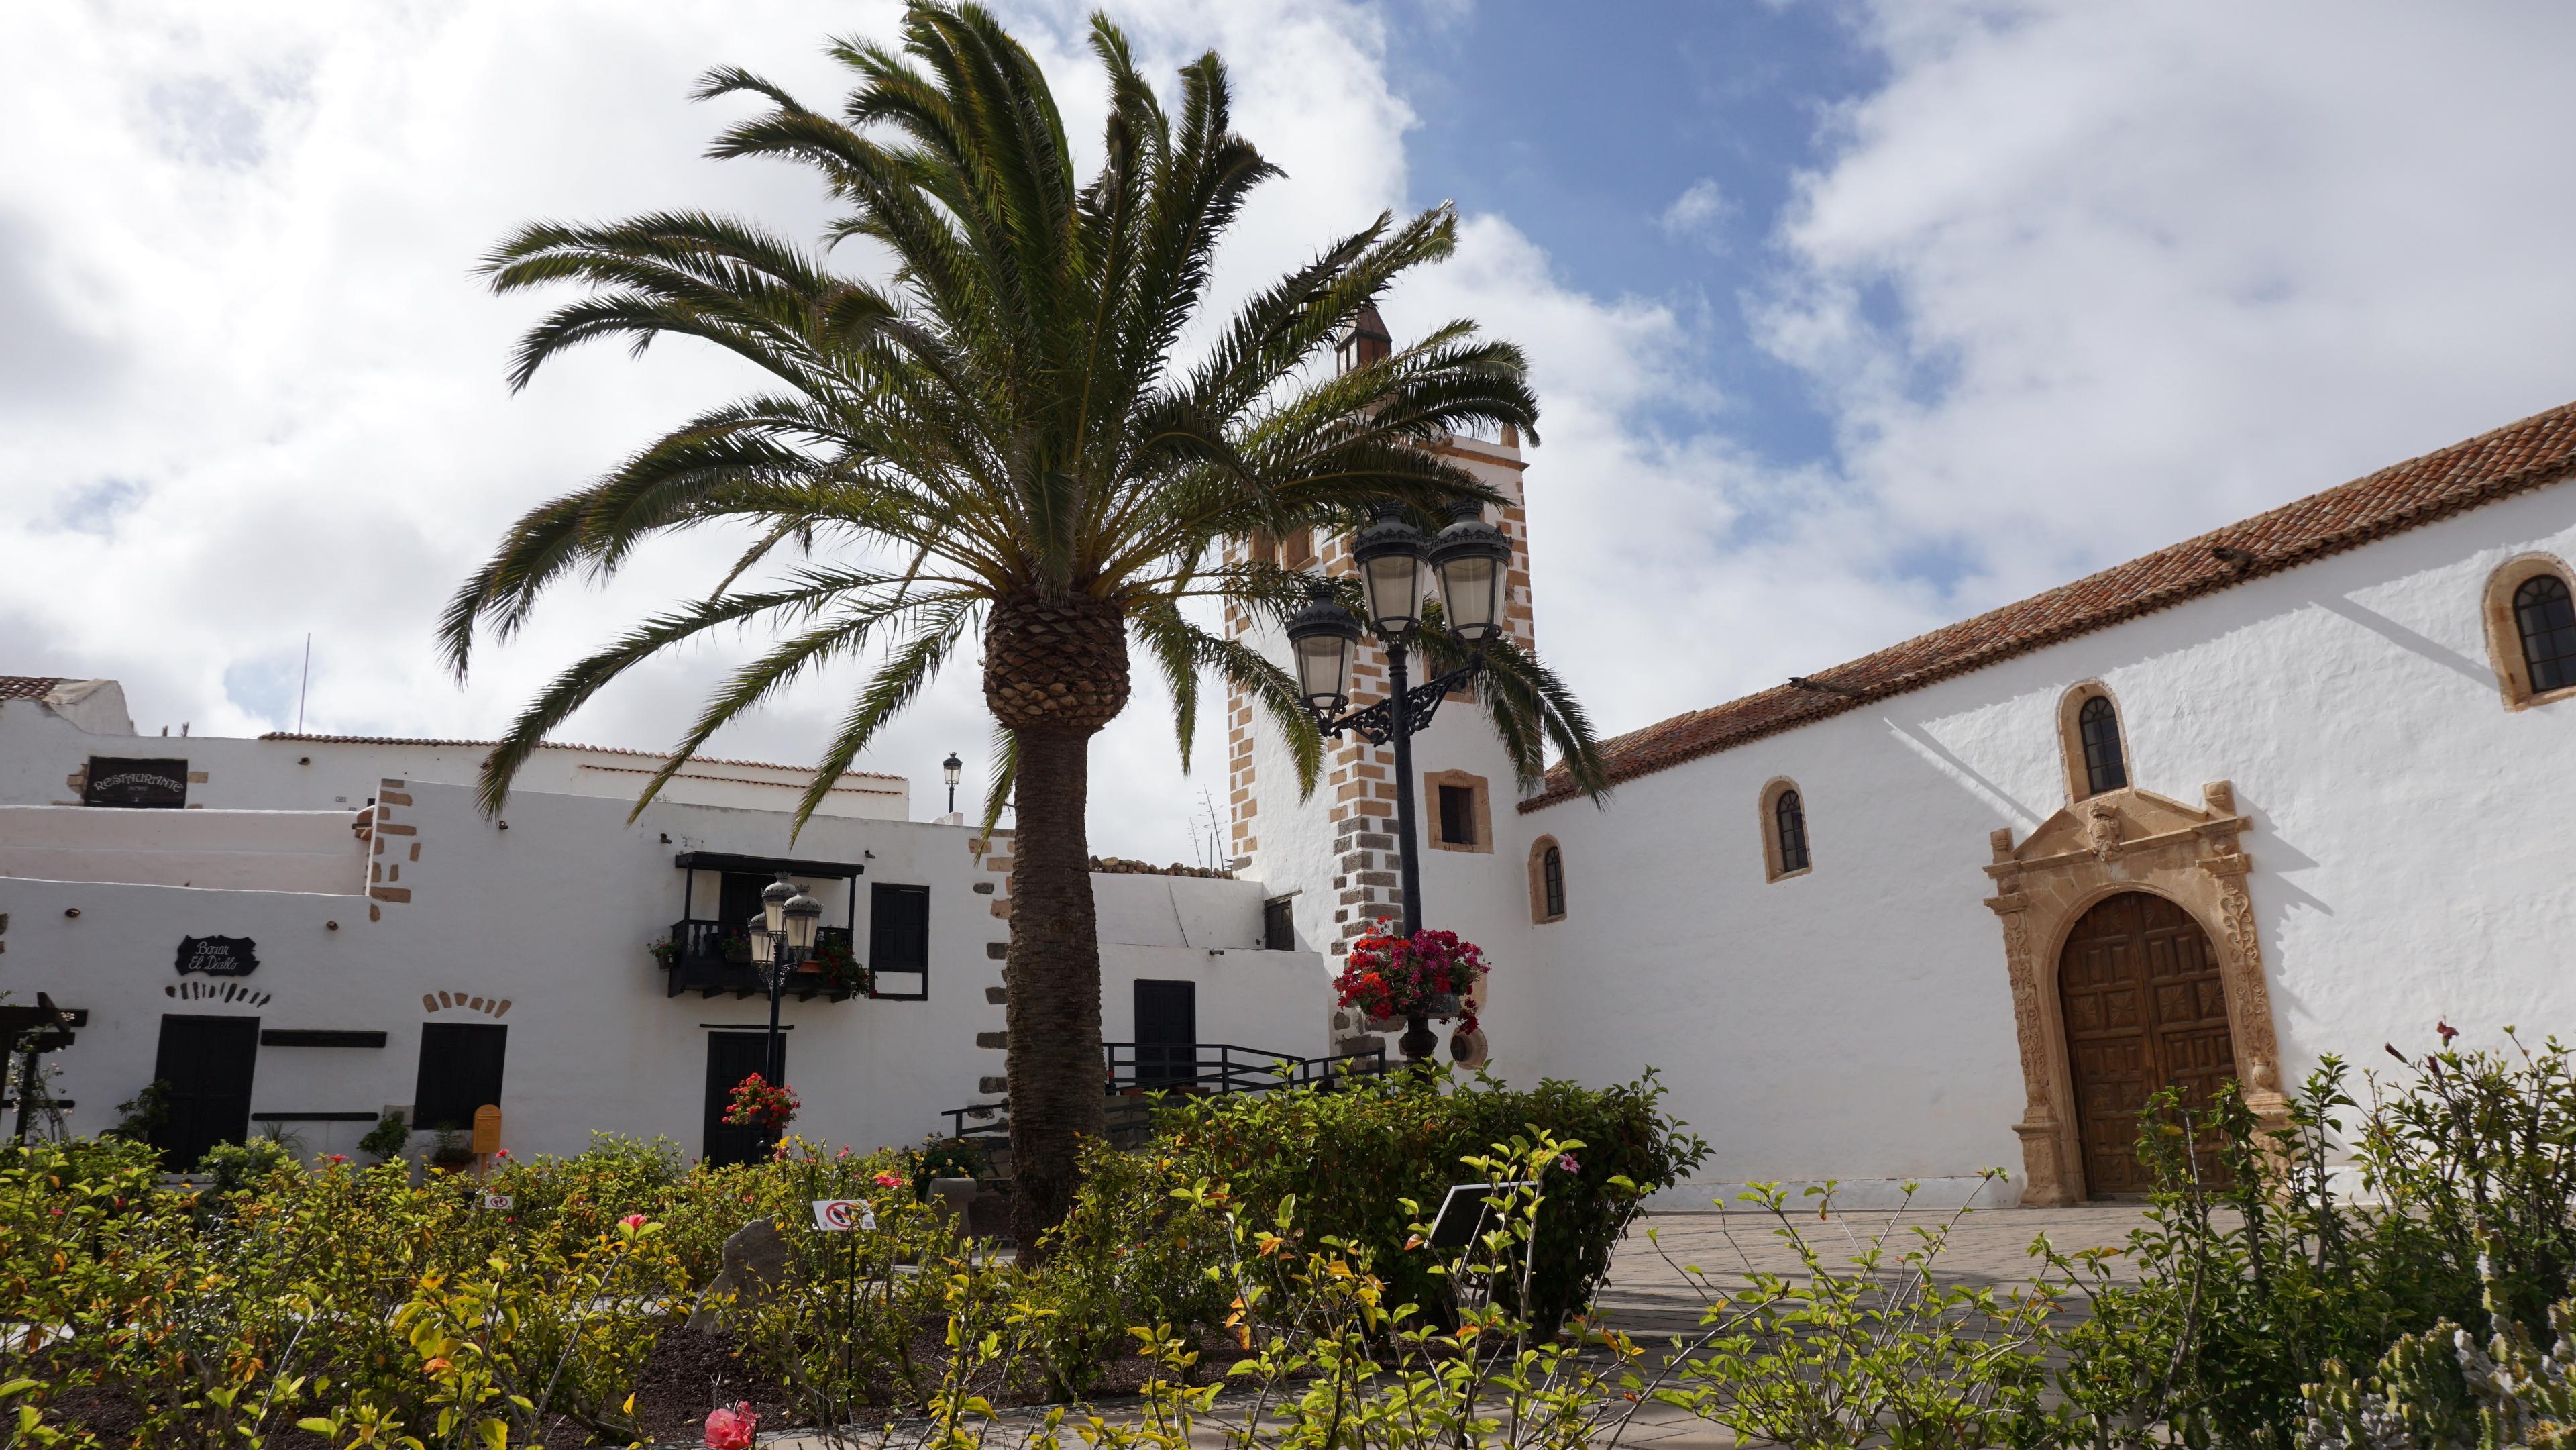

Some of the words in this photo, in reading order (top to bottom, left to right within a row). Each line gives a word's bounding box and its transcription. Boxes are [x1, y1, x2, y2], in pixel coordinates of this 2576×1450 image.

[93, 774, 184, 792] RESTAURANTE
[195, 941, 229, 955] Bazar
[189, 955, 204, 969] El
[204, 955, 239, 970] Diablo
